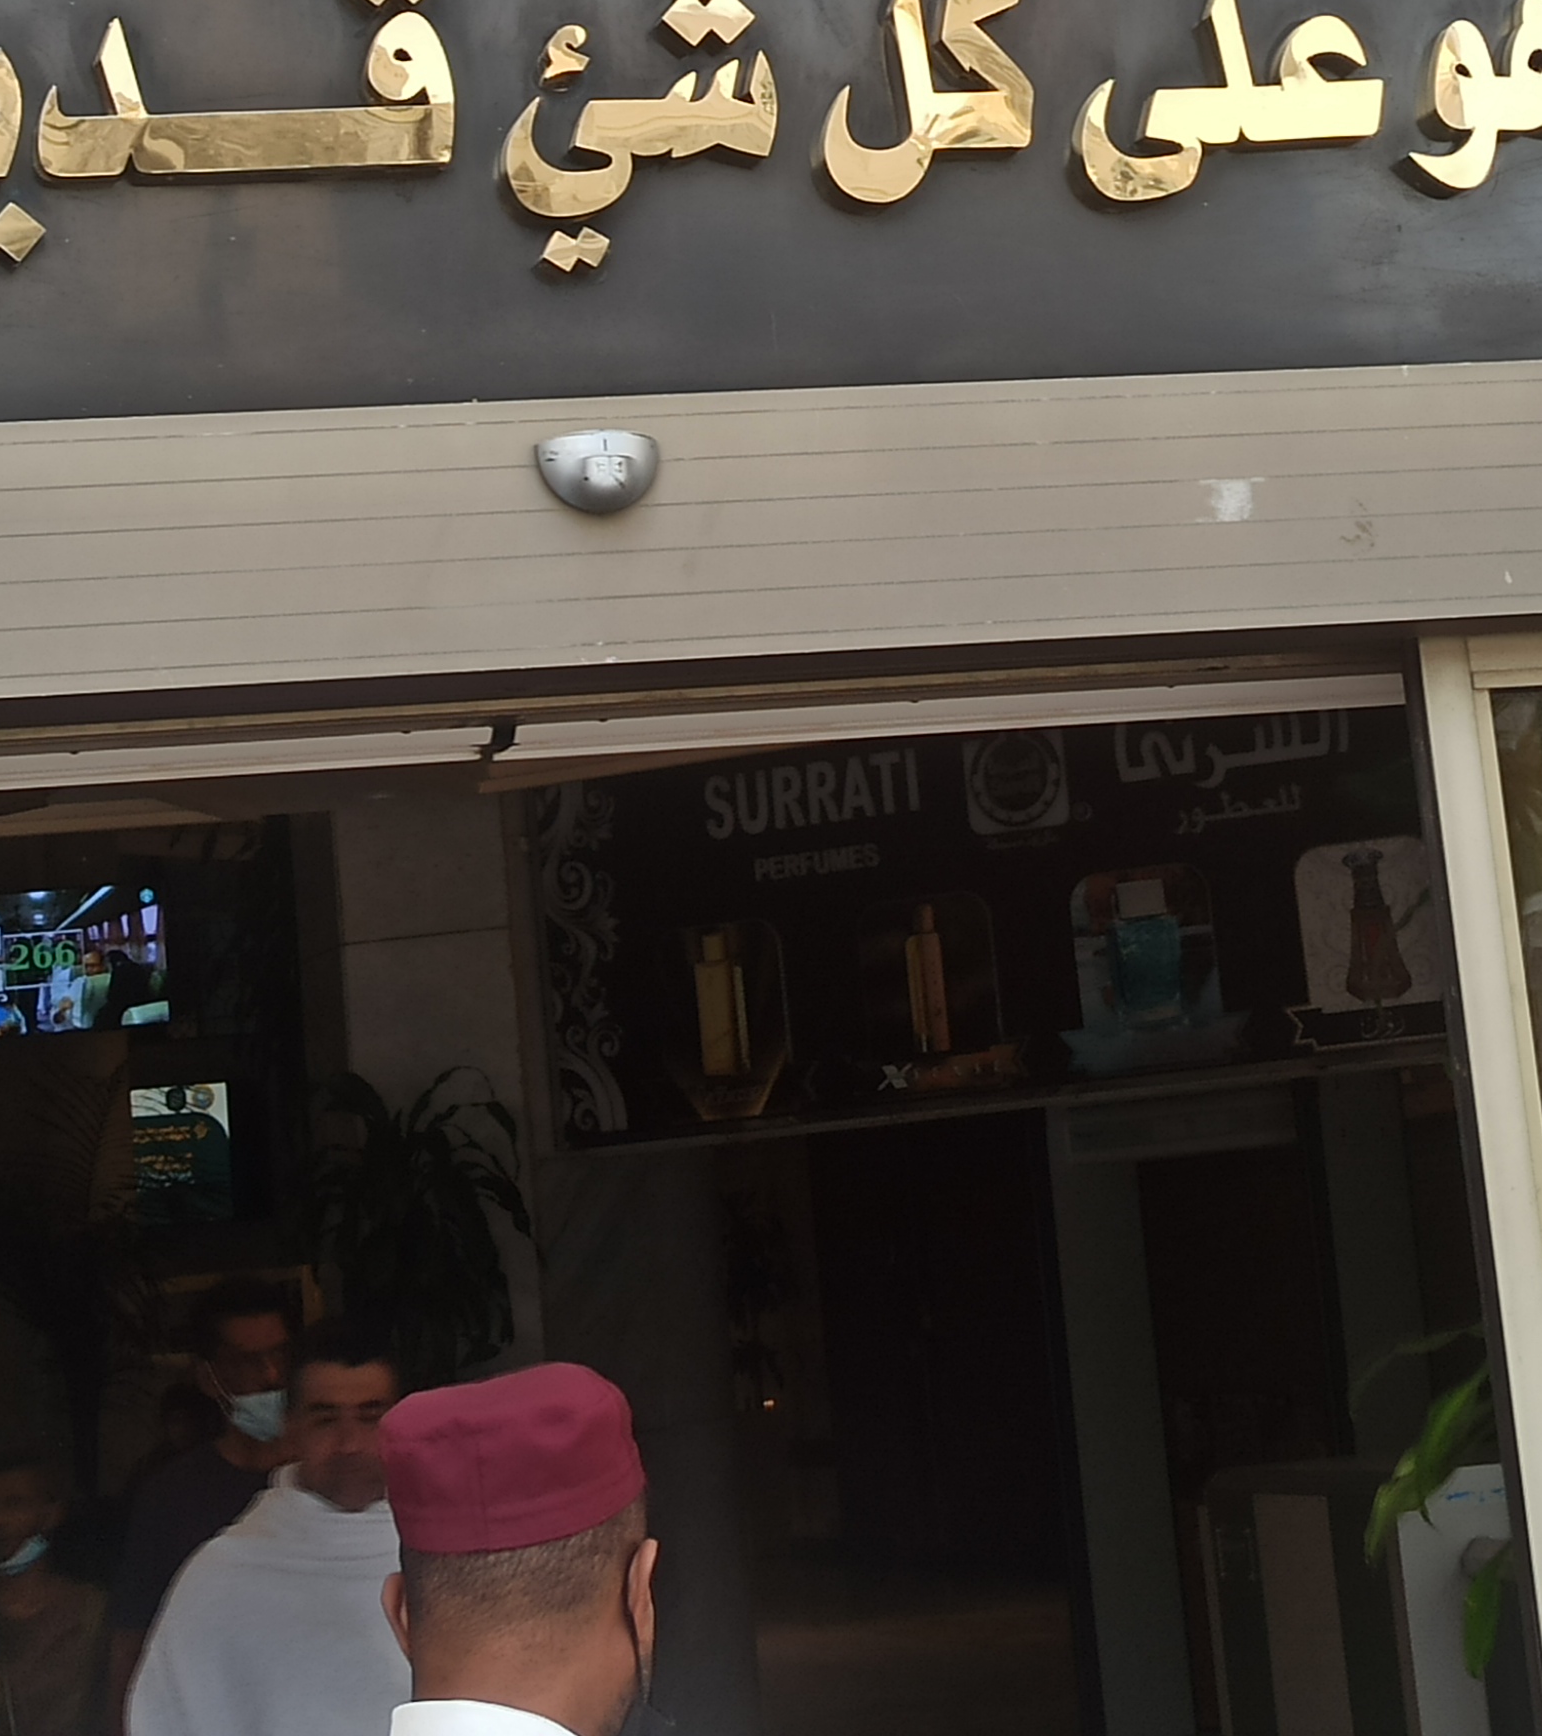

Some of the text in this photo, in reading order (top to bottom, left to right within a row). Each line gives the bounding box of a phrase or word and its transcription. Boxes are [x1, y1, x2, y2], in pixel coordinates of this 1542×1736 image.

[704, 748, 921, 841] SURRATI
[753, 842, 881, 883] PERFUMES
[9, 940, 77, 972] 266
